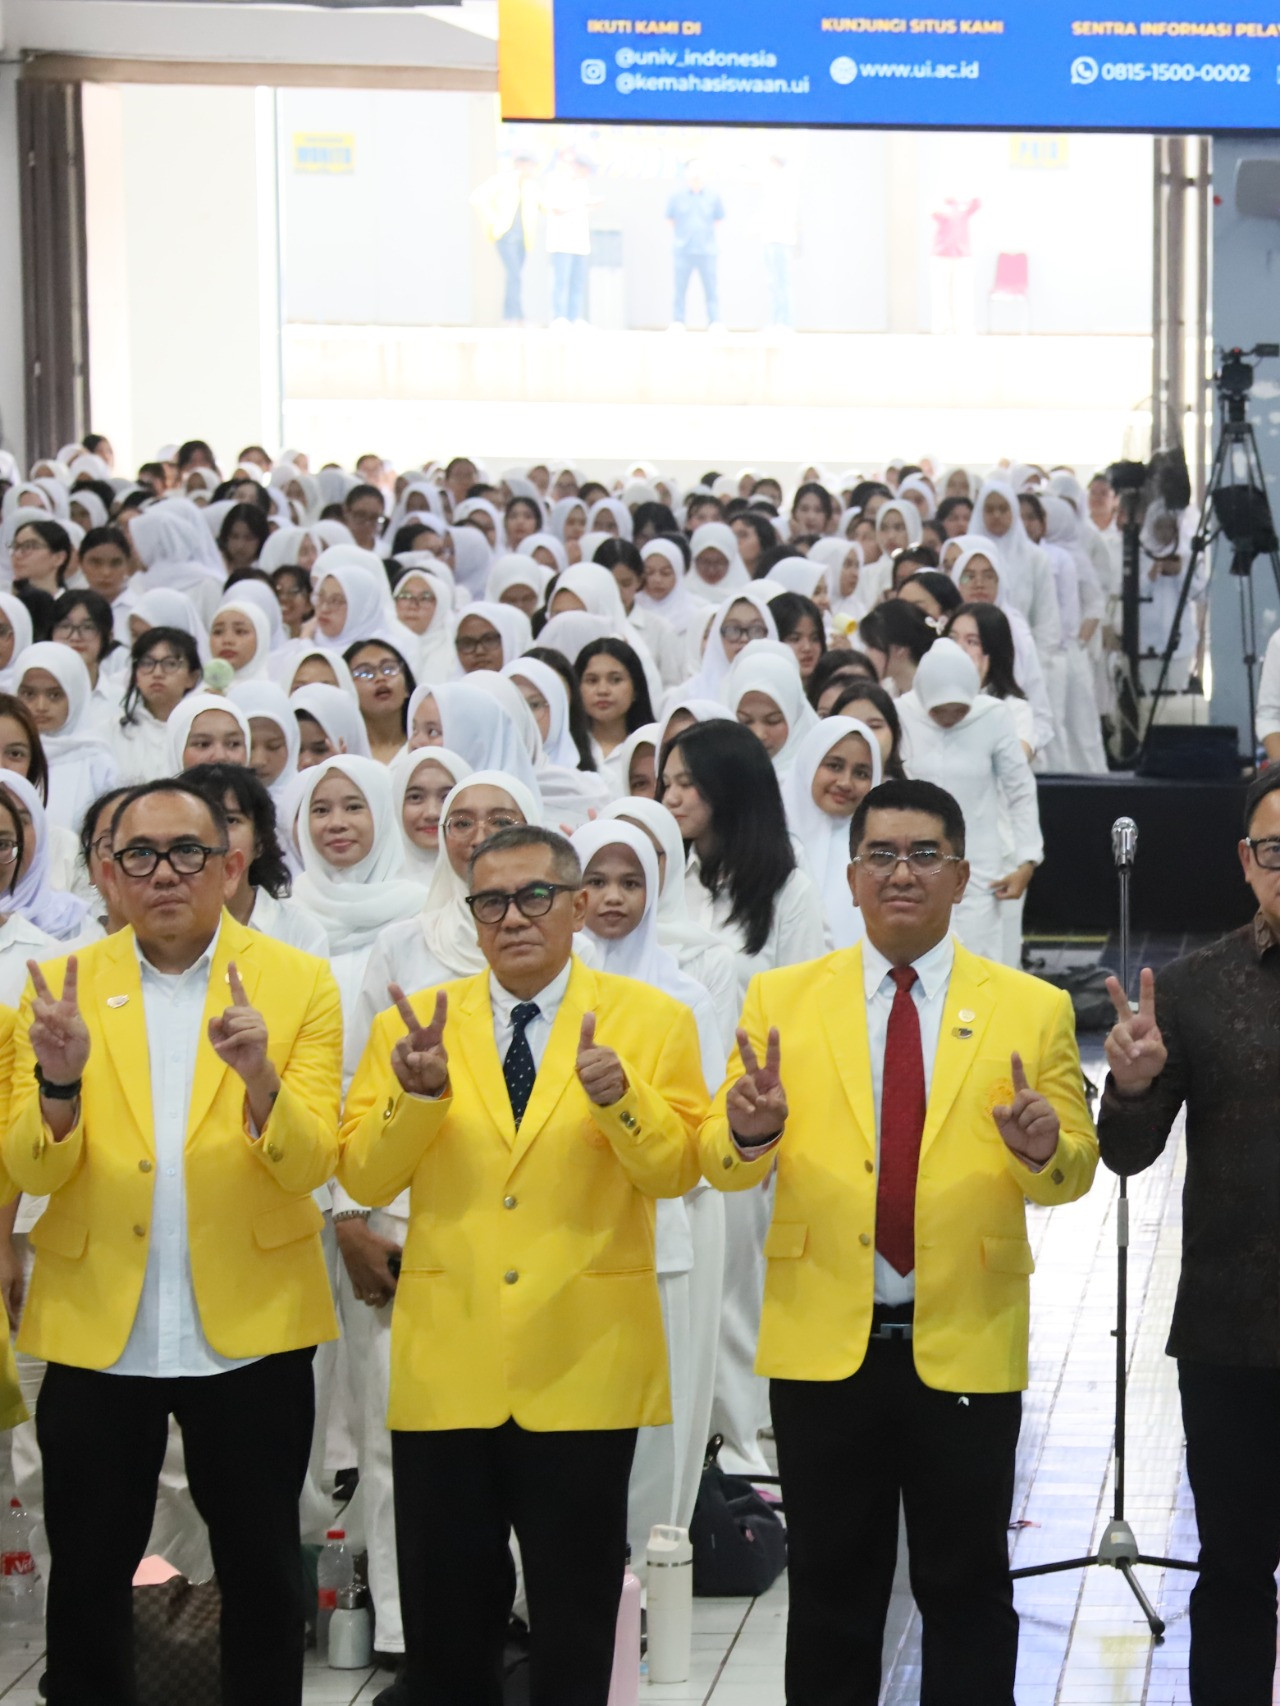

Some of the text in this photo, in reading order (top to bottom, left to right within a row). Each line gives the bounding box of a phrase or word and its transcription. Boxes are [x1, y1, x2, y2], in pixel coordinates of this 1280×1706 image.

[586, 19, 702, 35] IKUTI KAMI DI
[821, 18, 1004, 34] KUNJUNGI SITUS KAMI
[1071, 21, 1137, 36] SENTRA
[1140, 22, 1232, 37] INFORMASI
[615, 46, 778, 68] @univ_indonesia
[859, 60, 980, 79] www.ui.ac.id
[1101, 63, 1251, 82] 0815-1500-0002
[615, 72, 810, 94] @kemahasiswaan.ui
